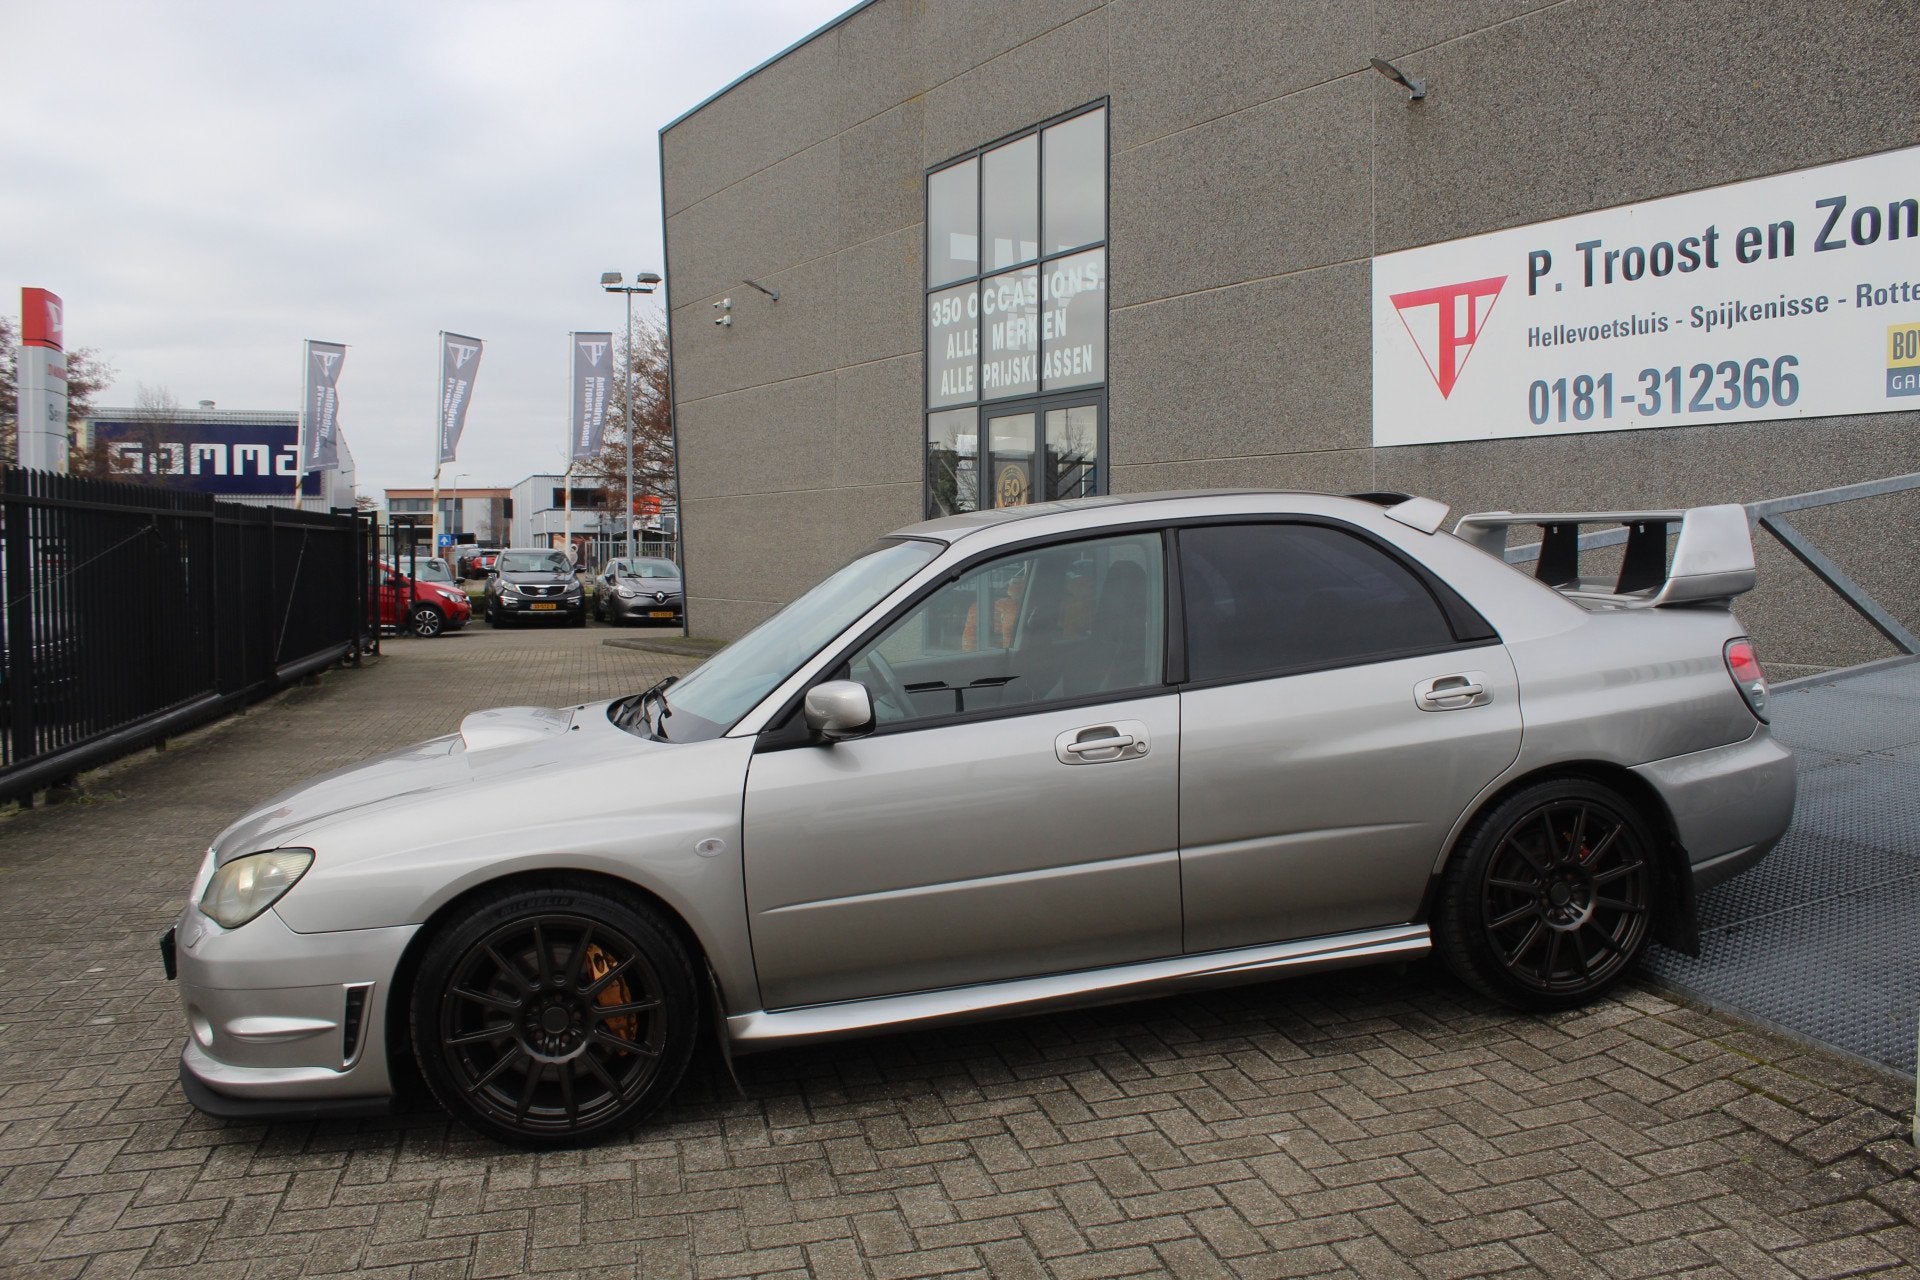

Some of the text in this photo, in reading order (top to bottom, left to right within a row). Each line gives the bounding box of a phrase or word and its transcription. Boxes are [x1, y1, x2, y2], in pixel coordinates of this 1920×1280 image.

[1528, 194, 1919, 297] P. Troost en Zon
[932, 261, 1099, 328] 350 OCCASIONS
[1528, 311, 1669, 348] Hellevoetsluis
[1690, 293, 1829, 333] Spijkenisse
[946, 307, 1067, 361] ALLE MERKEN
[1892, 328, 1920, 361] BO
[940, 343, 1093, 397] ALLE PRIJSKLASSEN
[1528, 354, 1800, 426] 0181-312366
[1892, 373, 1920, 391] GA
[593, 377, 605, 426] Autobedrijf
[1004, 479, 1020, 497] 50
